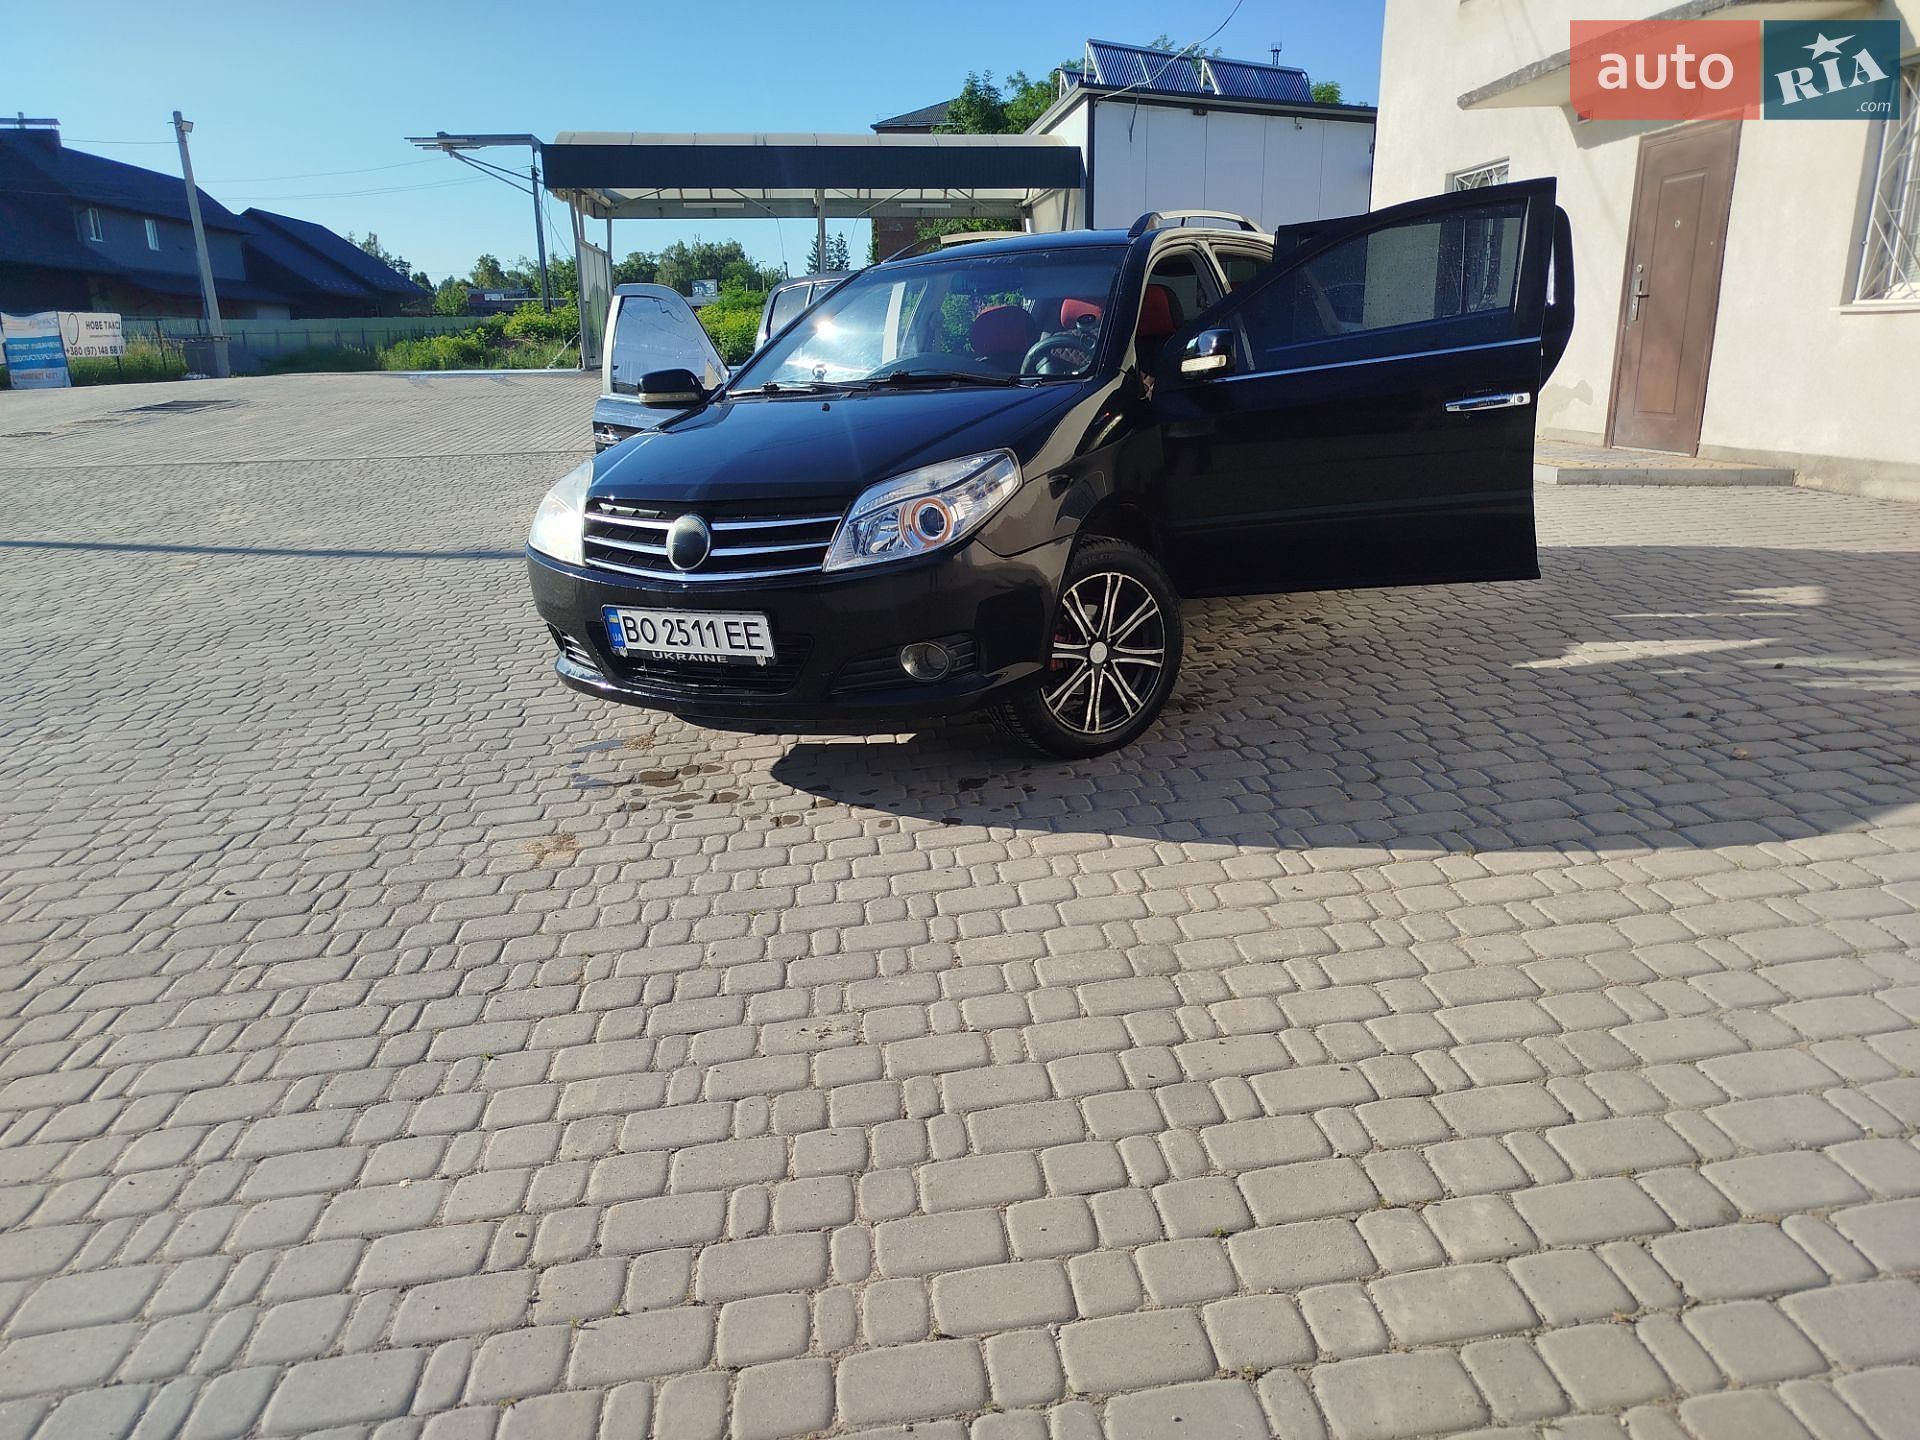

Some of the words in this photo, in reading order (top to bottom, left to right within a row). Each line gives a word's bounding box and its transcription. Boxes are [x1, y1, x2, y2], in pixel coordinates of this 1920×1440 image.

[85, 320, 103, 330] НОВЕ
[66, 346, 83, 356] +380
[84, 346, 97, 357] (97)
[612, 633, 624, 643] UA
[622, 616, 657, 644] BO
[661, 618, 720, 649] 2511
[723, 621, 765, 650] EE
[651, 651, 729, 664] UKRAINE
